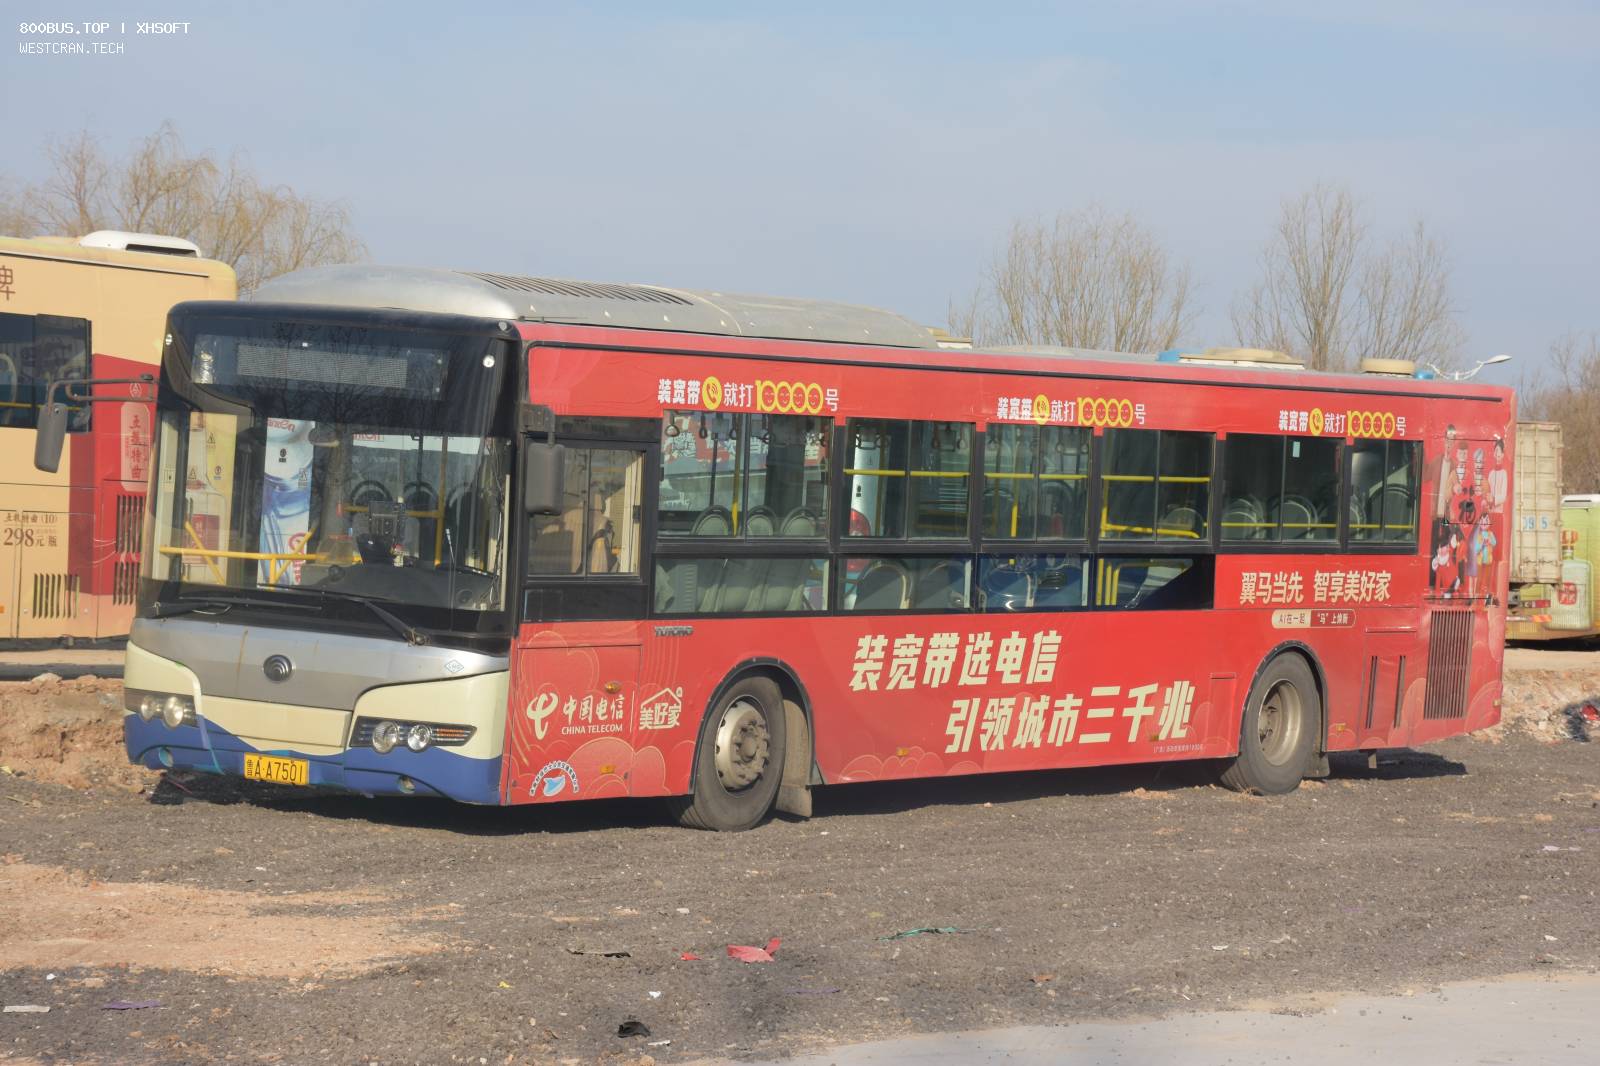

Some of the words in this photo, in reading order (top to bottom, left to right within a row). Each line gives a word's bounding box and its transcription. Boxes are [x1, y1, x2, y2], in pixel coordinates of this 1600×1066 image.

[657, 378, 700, 405] 装宽带
[1240, 571, 1304, 605] 翼马当先
[1313, 570, 1392, 603] 智享美好家
[849, 630, 1062, 691] 装宽带选电信
[561, 725, 586, 735] CHINA
[587, 723, 623, 734] TELECOM
[562, 694, 625, 725] 中国电信
[639, 702, 681, 730] 美好家
[945, 681, 1195, 753] 引领城市三千兆
